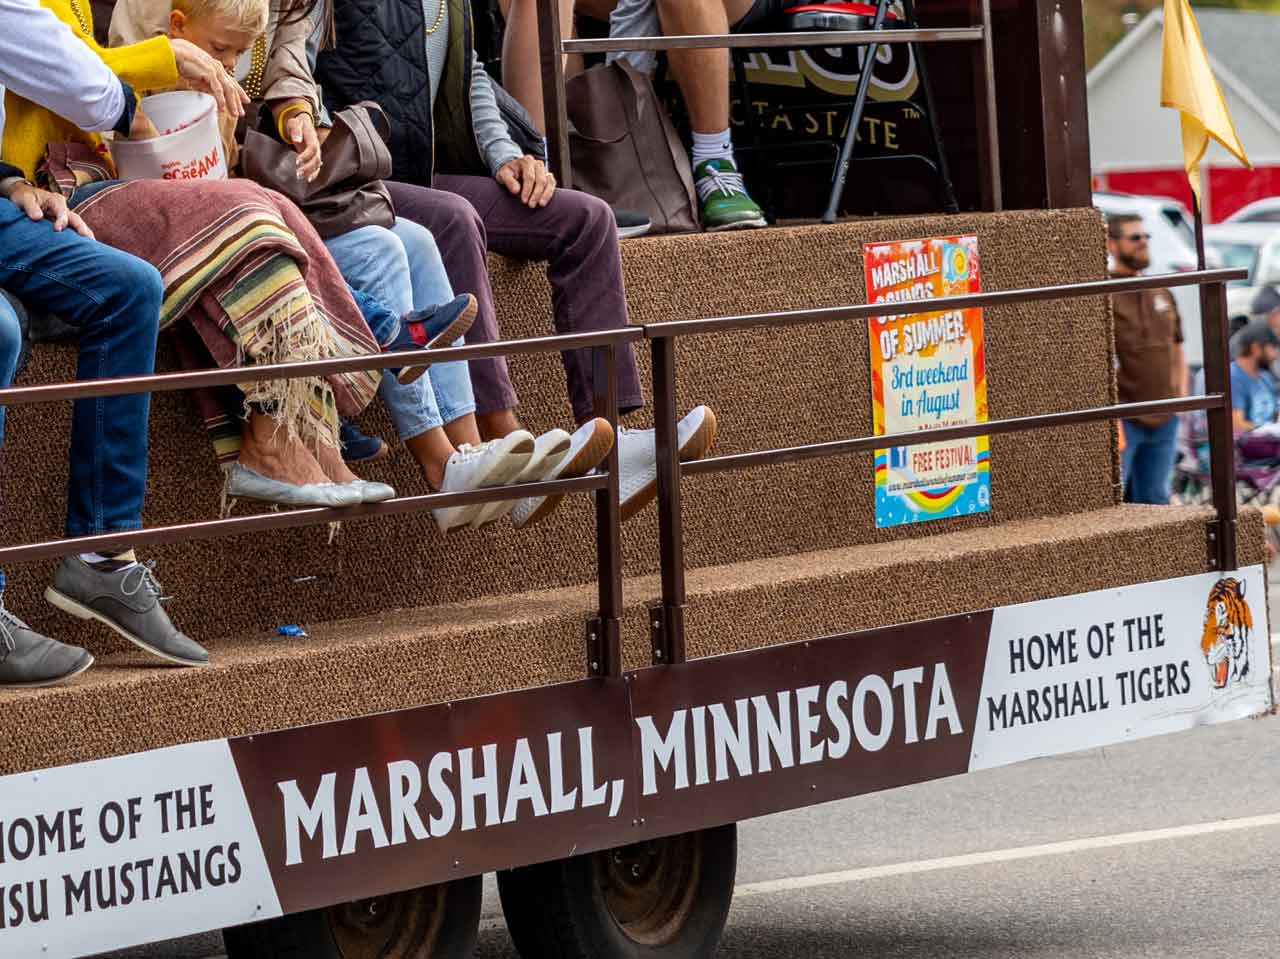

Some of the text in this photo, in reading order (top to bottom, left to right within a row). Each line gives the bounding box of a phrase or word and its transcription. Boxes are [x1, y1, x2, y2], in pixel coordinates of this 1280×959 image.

[871, 251, 939, 290] MARSHALL
[880, 311, 965, 360] OF SUMMER
[891, 358, 968, 390] 3rd weekend
[901, 389, 960, 420] in August
[913, 444, 975, 472] FREE FESTIVAL
[1009, 613, 1165, 673] HOME OF THE
[987, 660, 1191, 731] MARSHALL TIGERS
[277, 662, 965, 866] MARSHALL, MINNESOTA
[99, 797, 142, 844] OF
[154, 784, 215, 833] THE
[61, 842, 242, 916] MUSTANGS
